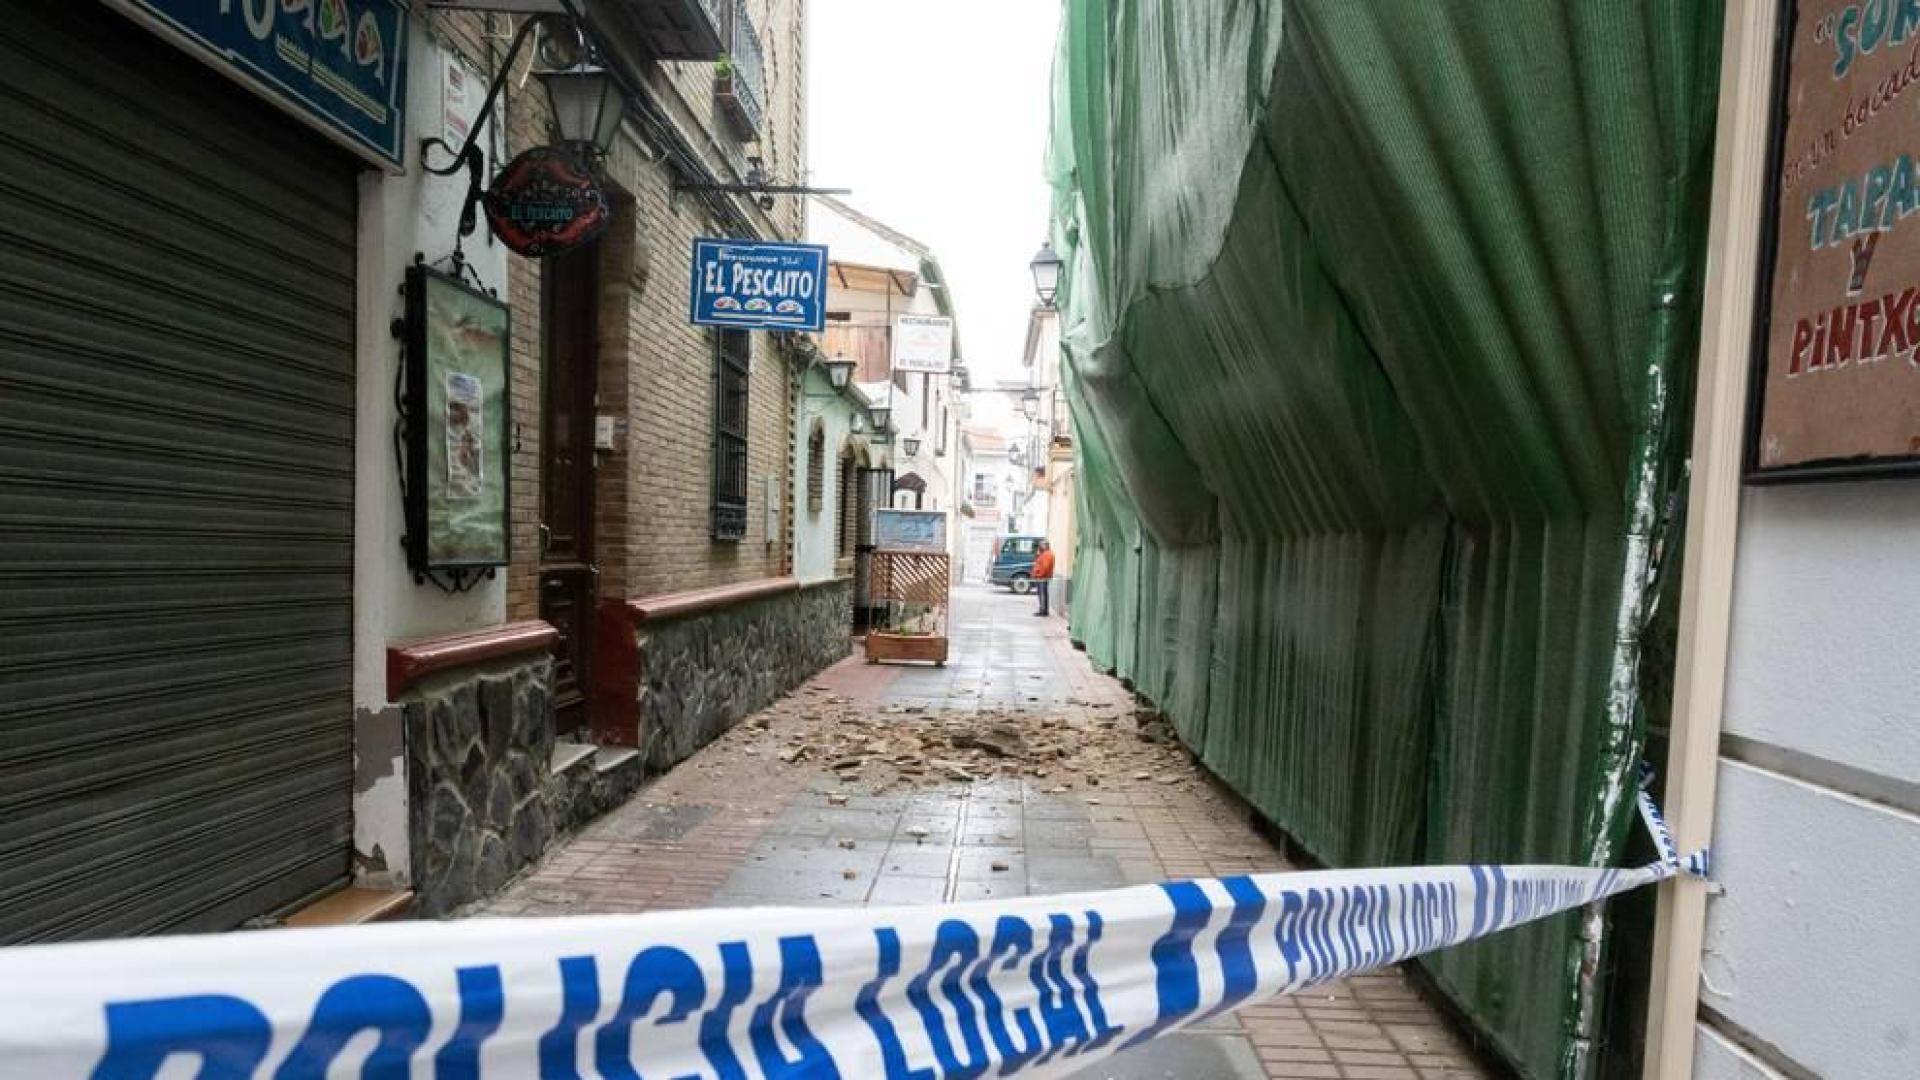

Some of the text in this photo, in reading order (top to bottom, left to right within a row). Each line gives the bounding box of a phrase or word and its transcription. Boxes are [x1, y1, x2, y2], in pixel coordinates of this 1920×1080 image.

[1805, 153, 1920, 251] TAPA
[705, 261, 813, 299] EL PESCAITO
[1846, 230, 1880, 297] Y
[855, 910, 1125, 1080] LOCAL
